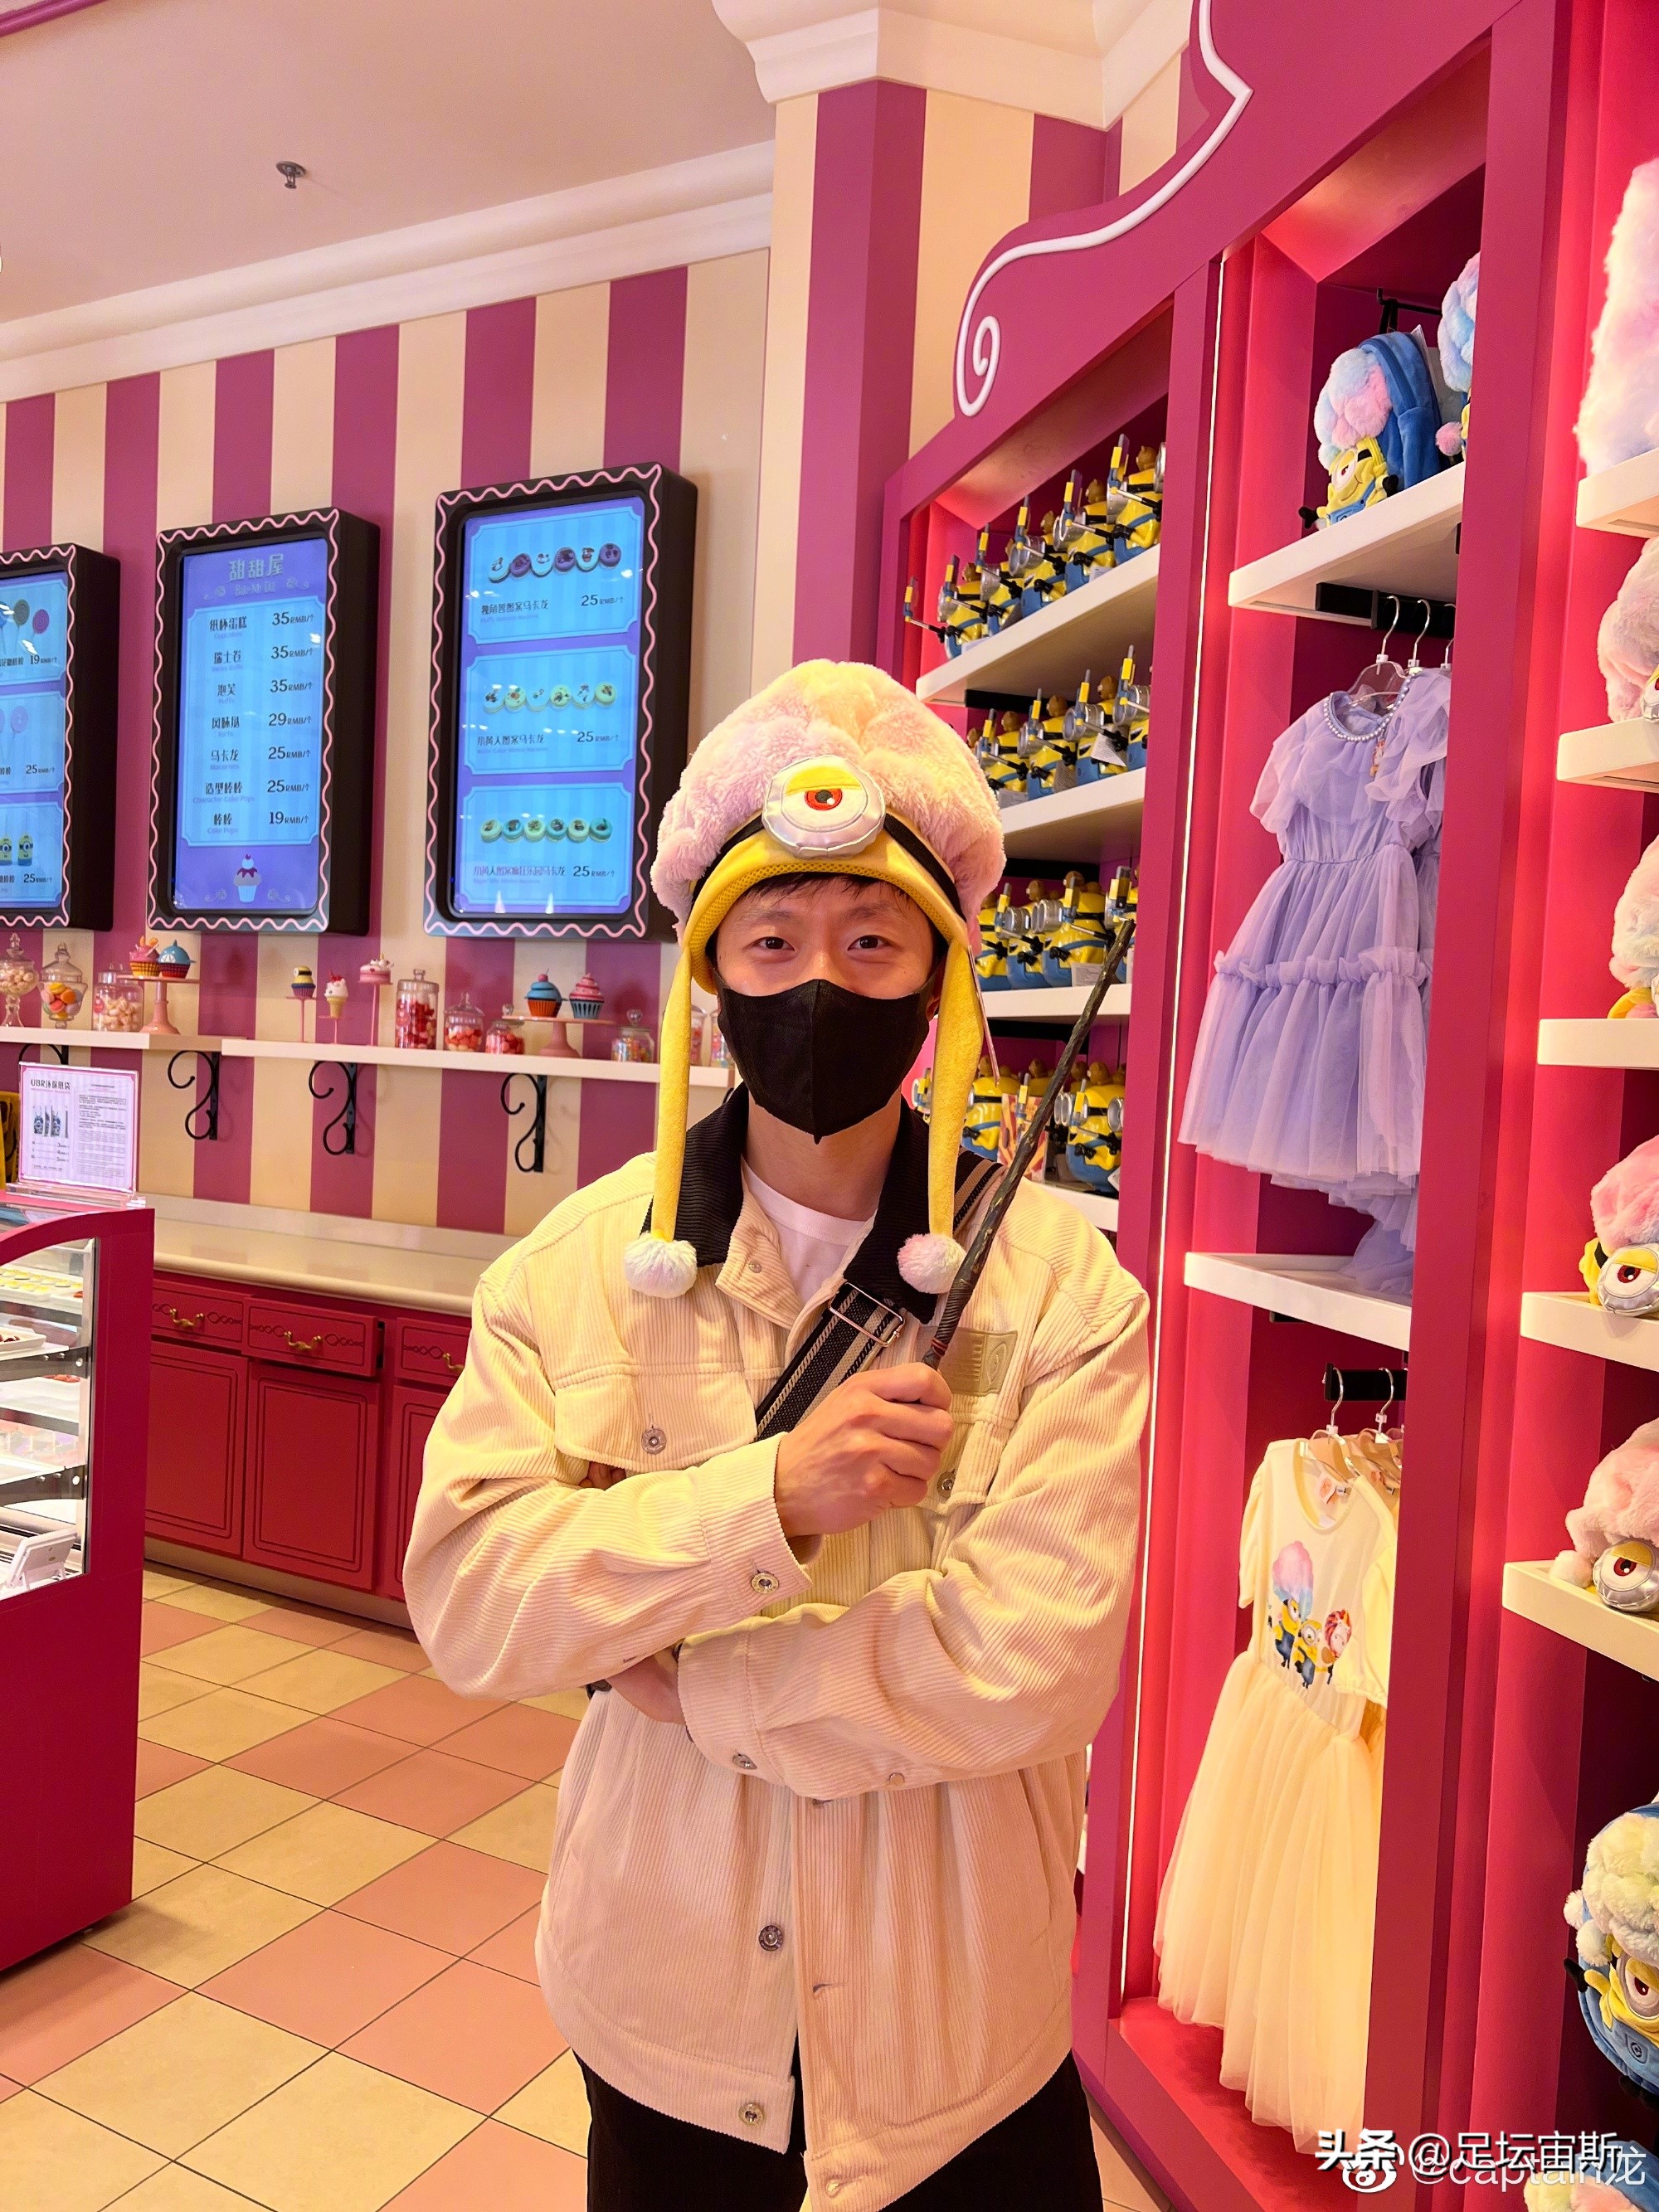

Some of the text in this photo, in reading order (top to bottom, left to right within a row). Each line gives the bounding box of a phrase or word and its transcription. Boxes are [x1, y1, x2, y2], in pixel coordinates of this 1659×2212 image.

[229, 553, 284, 582] 甜甜屋
[209, 615, 247, 632] 纸杯蛋糕
[213, 649, 242, 664] 瑞士卷
[216, 683, 236, 696] 泡芙
[211, 748, 239, 762] 马卡龙
[205, 781, 242, 795] 造型棒棒
[213, 812, 232, 826] 棒棒
